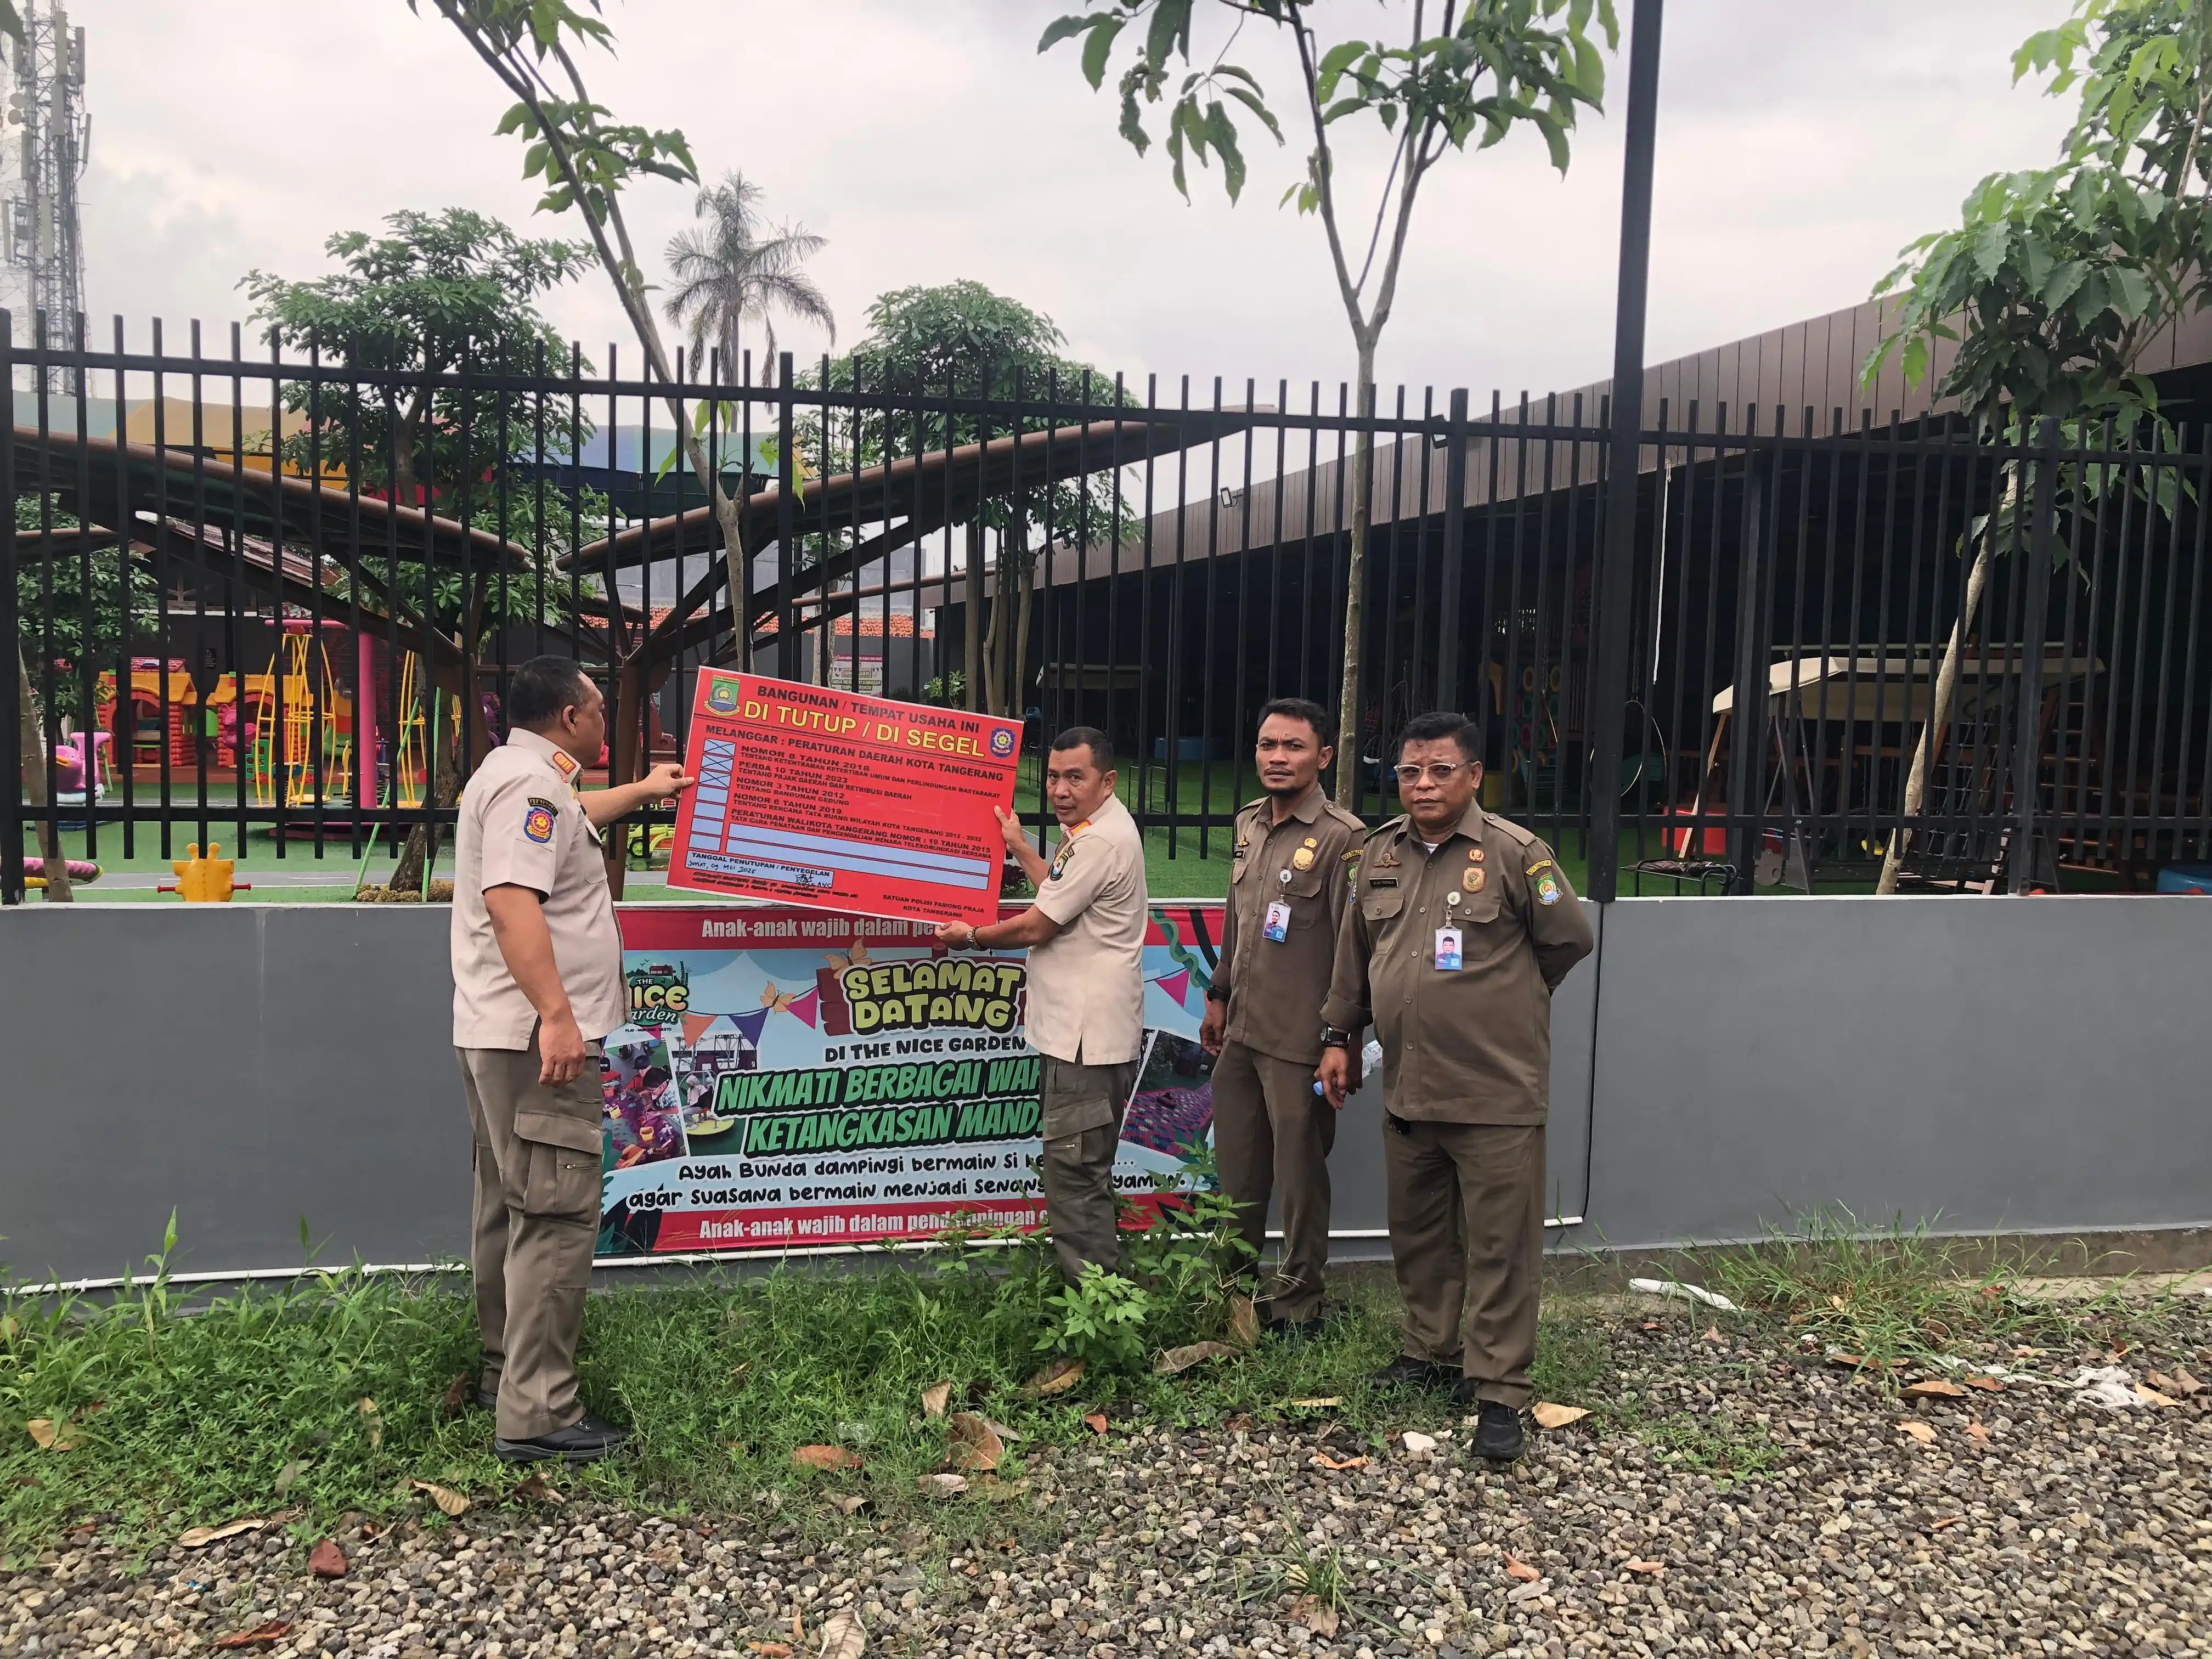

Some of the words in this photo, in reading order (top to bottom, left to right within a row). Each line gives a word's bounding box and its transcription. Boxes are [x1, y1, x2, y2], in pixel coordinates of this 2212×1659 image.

[757, 685, 838, 709] BANGUNAN
[850, 701, 904, 720] TEMPAT
[909, 713, 956, 729] USAHA
[960, 720, 979, 733] INI
[743, 699, 769, 721] DI
[776, 705, 857, 735] TUTUP
[876, 723, 900, 743] DI
[906, 728, 985, 758] SEGEL
[706, 724, 778, 744] MELANGGAR
[787, 738, 855, 757] PERATURAN
[859, 749, 903, 765] DAERAH
[906, 758, 934, 770] KOTA
[938, 763, 1003, 781] TANGERANG
[741, 745, 785, 758] NOMOR
[800, 754, 839, 766] TAHUN
[843, 761, 869, 771] 2018
[738, 760, 771, 771] PERDA
[789, 769, 822, 779] TAHUN
[825, 775, 847, 783] 2023
[738, 768, 771, 777] TENTANG
[774, 773, 797, 781] PAJAK
[798, 777, 827, 786] DAERAH
[845, 785, 882, 795] RETRIBUSI
[883, 790, 912, 800] DAERAH
[741, 752, 772, 761] TENTANG
[774, 757, 824, 770] KETENTRAMAN
[826, 766, 868, 777] KETERTIBAN
[906, 778, 957, 791] PERLINDUNGAN
[958, 787, 1000, 798] MASYARAKAT
[736, 776, 773, 787] NOMOR
[785, 784, 819, 794] TAHUN
[822, 790, 844, 799] 2012
[736, 783, 771, 793] TENTANG
[774, 789, 816, 800] BANGUNAN
[818, 797, 849, 805] GEDUNG
[733, 792, 770, 803] NOMOR
[783, 800, 816, 810] TAHUN
[819, 806, 842, 814] 2019
[731, 808, 785, 821] PERATURAN
[787, 817, 832, 829] WALIKOTA
[834, 824, 887, 837] TANGERANG
[890, 832, 921, 842] NOMOR
[940, 840, 969, 850] TAHUN
[970, 845, 990, 853] 2015
[770, 821, 805, 831] PENATAAN
[822, 828, 873, 840] PENGENDALIAN
[874, 837, 901, 845] MENARA
[904, 841, 960, 854] TELEKOMUNIKASI
[961, 849, 991, 859] BERSAMA
[691, 851, 727, 862] TANGGAL
[729, 857, 775, 868] PENUTUPAN
[780, 865, 830, 877] PENYEGELAN
[922, 907, 962, 917] TANGERANG
[934, 901, 962, 910] PAMONG
[702, 919, 796, 938] Anak-anak
[802, 918, 849, 938] wajib
[854, 919, 908, 936] dalam
[845, 962, 1022, 1000] SELAMAT
[629, 985, 688, 1011] ICE
[855, 993, 1012, 1029] DATANG
[631, 1005, 676, 1022] arden
[825, 1046, 845, 1062] DI
[850, 1042, 891, 1059] THE
[896, 1038, 944, 1054] NICE
[948, 1036, 1026, 1052] GARDEN
[716, 1067, 840, 1112] NIKMATI
[844, 1060, 980, 1104] BERBAGAI
[747, 1102, 952, 1153] KETANGKASAN
[957, 1101, 1043, 1137] MAND
[679, 1164, 732, 1181] Ayah
[629, 1190, 682, 1208] agar
[700, 1217, 793, 1239] Anak-anak
[798, 1215, 845, 1236] wajib
[849, 1212, 904, 1232] dalam
